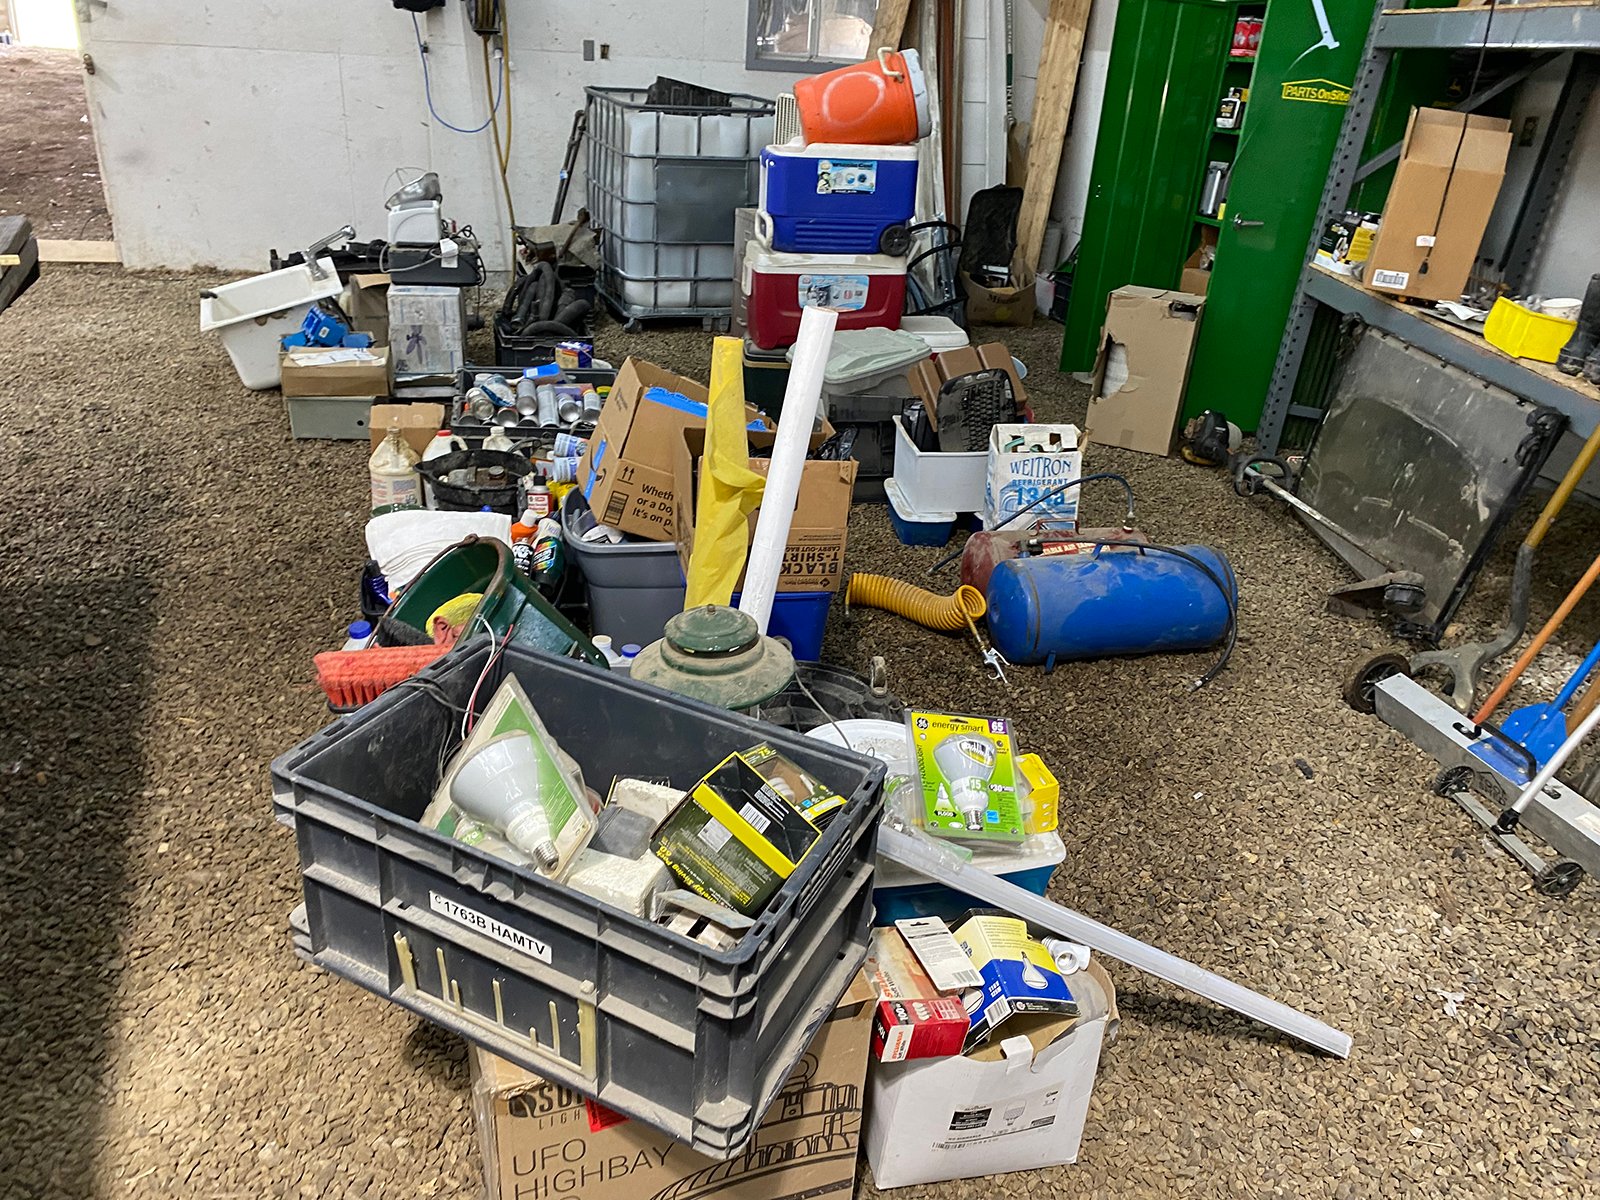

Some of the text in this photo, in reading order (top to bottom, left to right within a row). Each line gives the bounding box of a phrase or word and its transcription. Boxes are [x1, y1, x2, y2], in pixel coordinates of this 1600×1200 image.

[1285, 85, 1317, 99] PARTS
[1010, 456, 1072, 478] WEITRON
[1013, 478, 1068, 487] REFRIGERANT
[642, 483, 674, 502] Wheth
[637, 497, 649, 506] or
[649, 501, 656, 509] a
[632, 507, 673, 527] It's on p
[783, 551, 840, 563] T-SHIRT
[780, 562, 838, 575] BLACK
[932, 720, 960, 732] energy
[960, 724, 984, 732] smart
[991, 720, 1004, 732] 65
[970, 779, 981, 790] 15
[444, 901, 487, 929] 1763B
[490, 922, 546, 955] HAMTV
[891, 1031, 905, 1060] SYLVANIA
[513, 1138, 587, 1176] UFO
[514, 1141, 676, 1200] HIGHBAY
